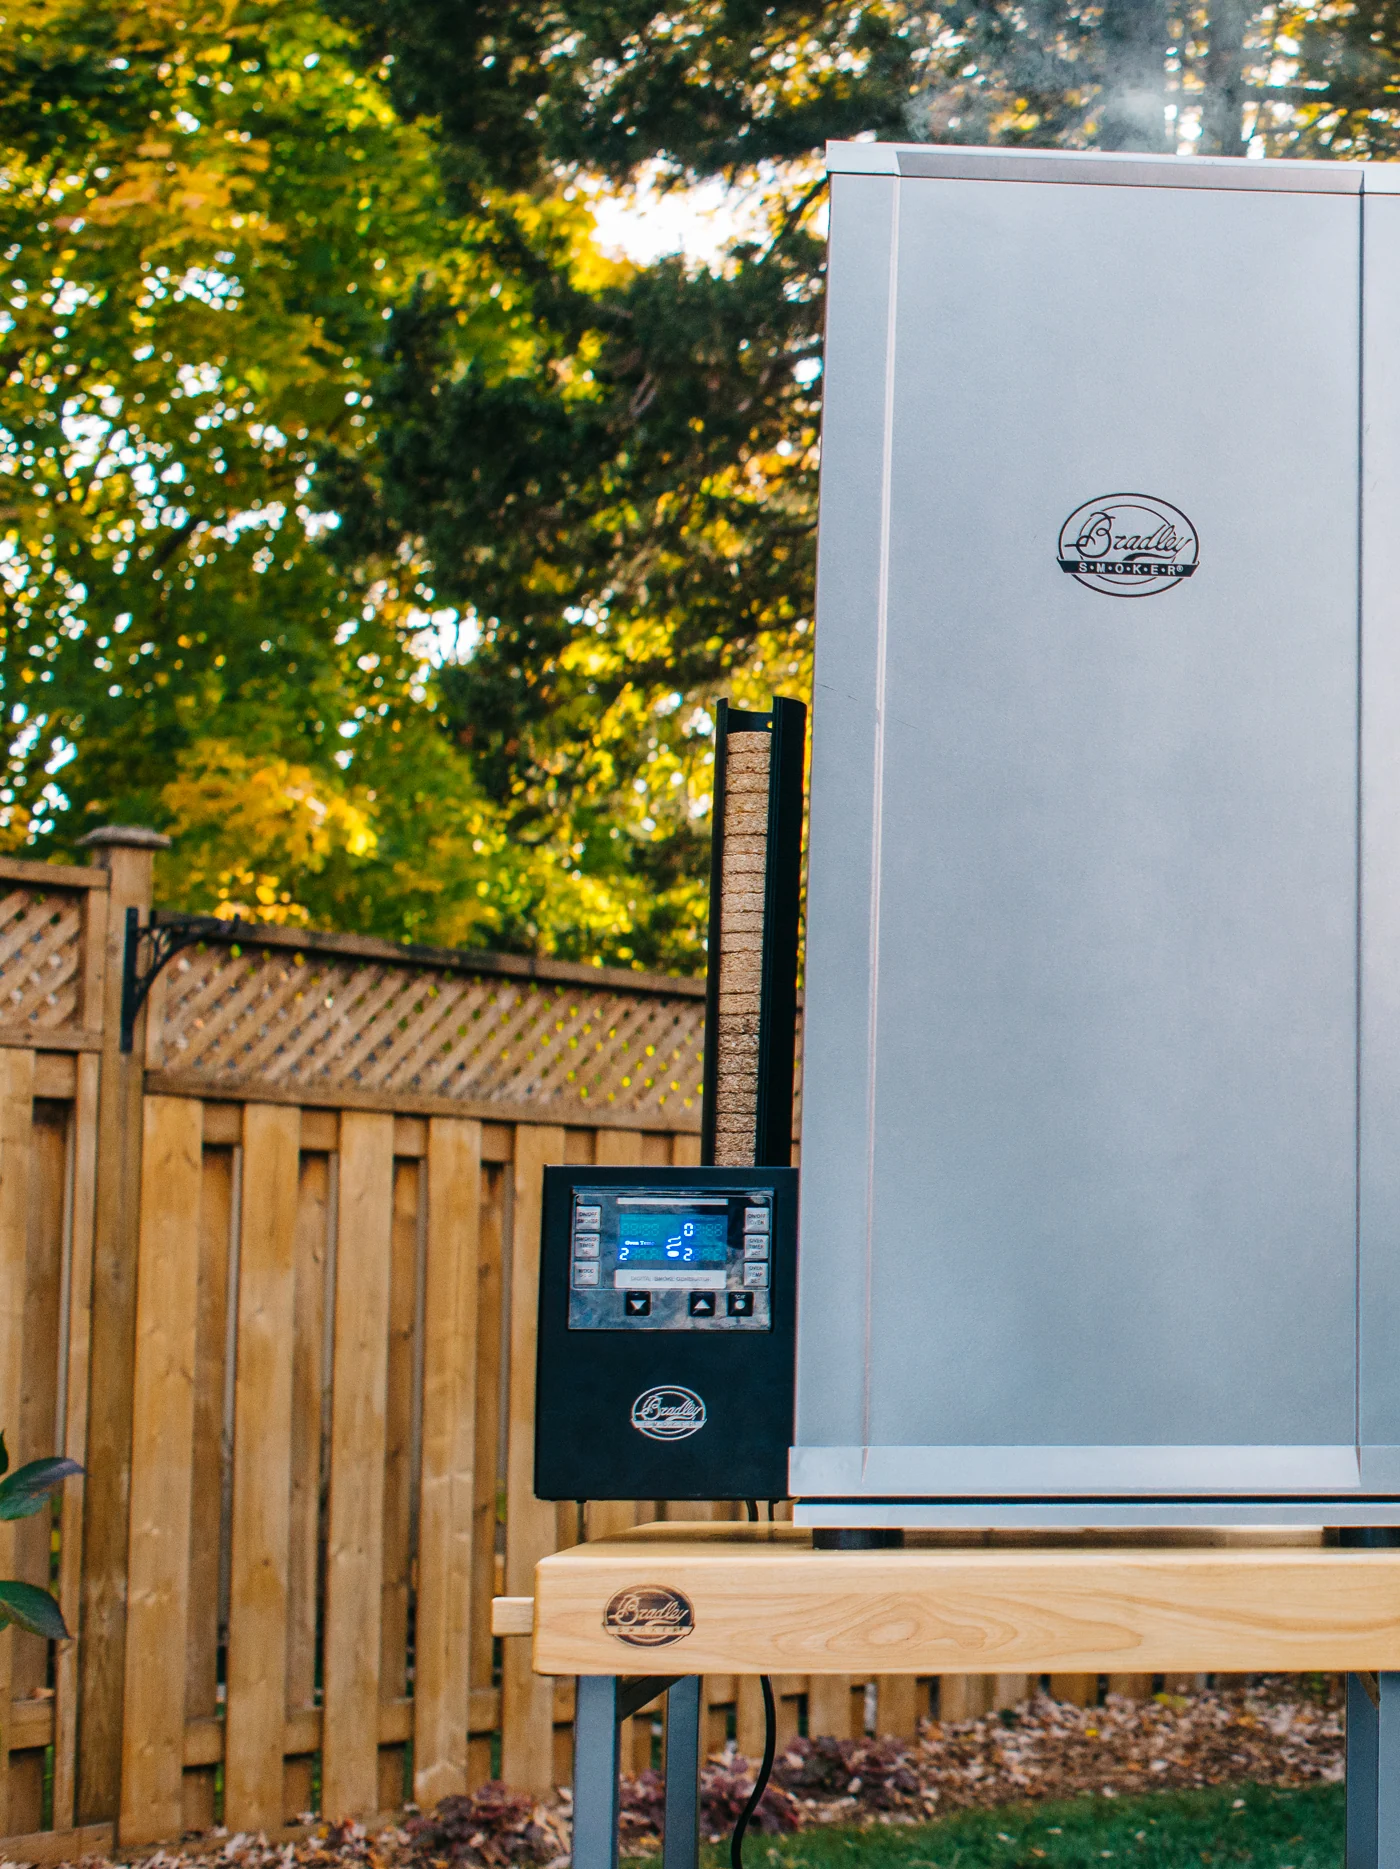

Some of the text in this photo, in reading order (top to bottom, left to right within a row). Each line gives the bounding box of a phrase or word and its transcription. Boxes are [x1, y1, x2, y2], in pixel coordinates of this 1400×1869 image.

[1064, 511, 1193, 561] Bradley
[635, 1394, 704, 1422] Bradley
[608, 1593, 690, 1627] Bradley
